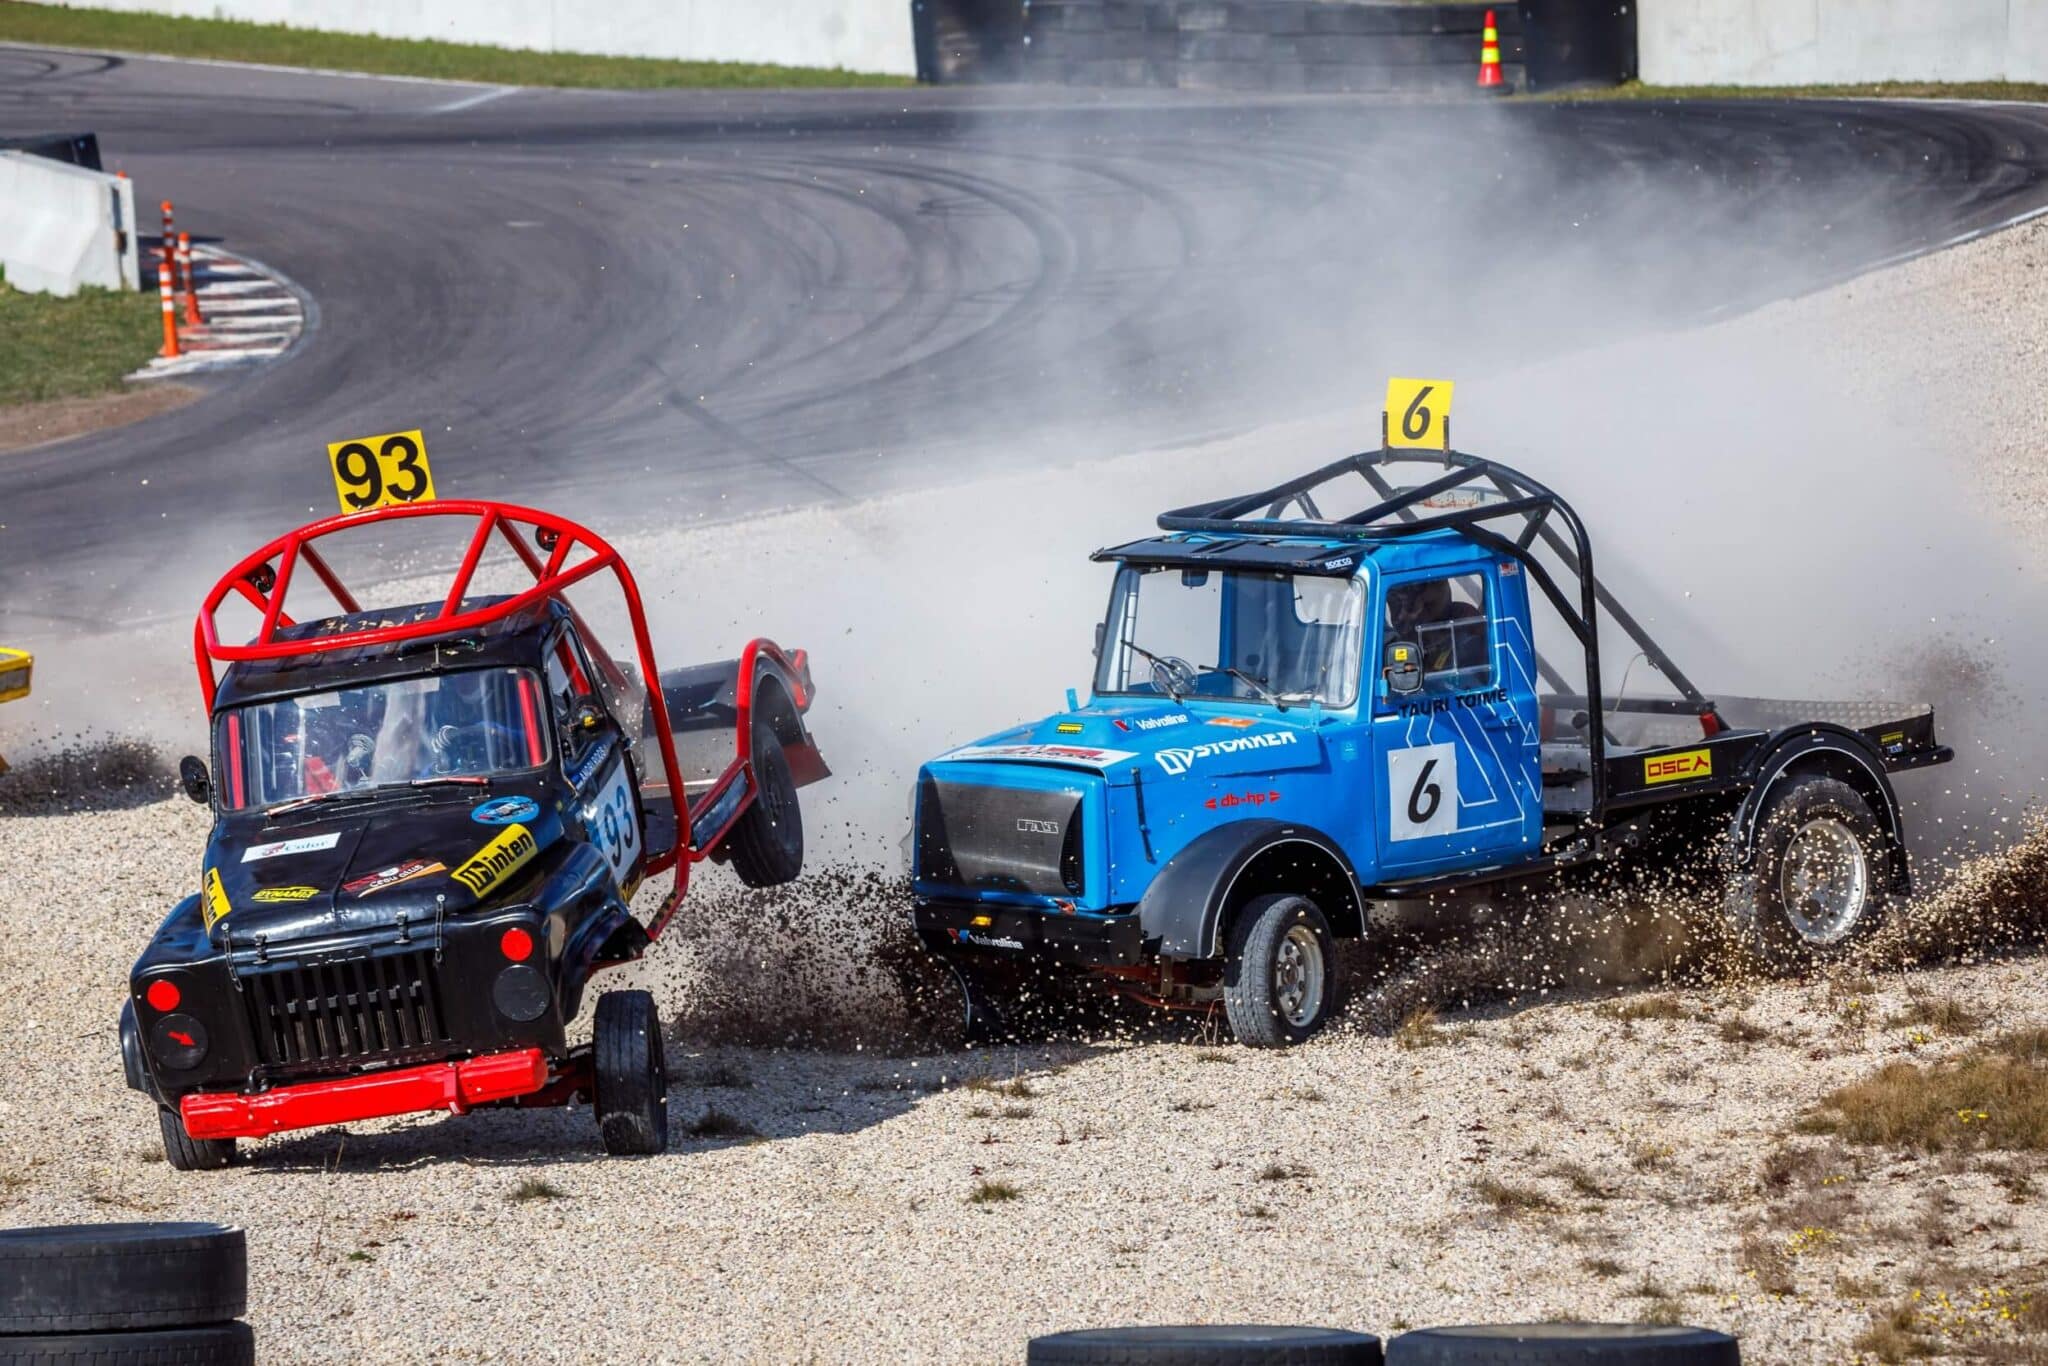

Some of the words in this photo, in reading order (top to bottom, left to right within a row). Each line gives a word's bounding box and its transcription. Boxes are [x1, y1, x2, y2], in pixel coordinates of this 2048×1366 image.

[1403, 386, 1434, 440] 6
[335, 435, 428, 508] 93
[1135, 713, 1189, 731] Valvoline
[1400, 697, 1449, 718] TAURI
[1456, 688, 1509, 709] TOIME
[1192, 731, 1298, 758] STOKKER
[1647, 755, 1709, 777] OSCA
[1407, 758, 1441, 824] 6
[604, 785, 634, 867] 93
